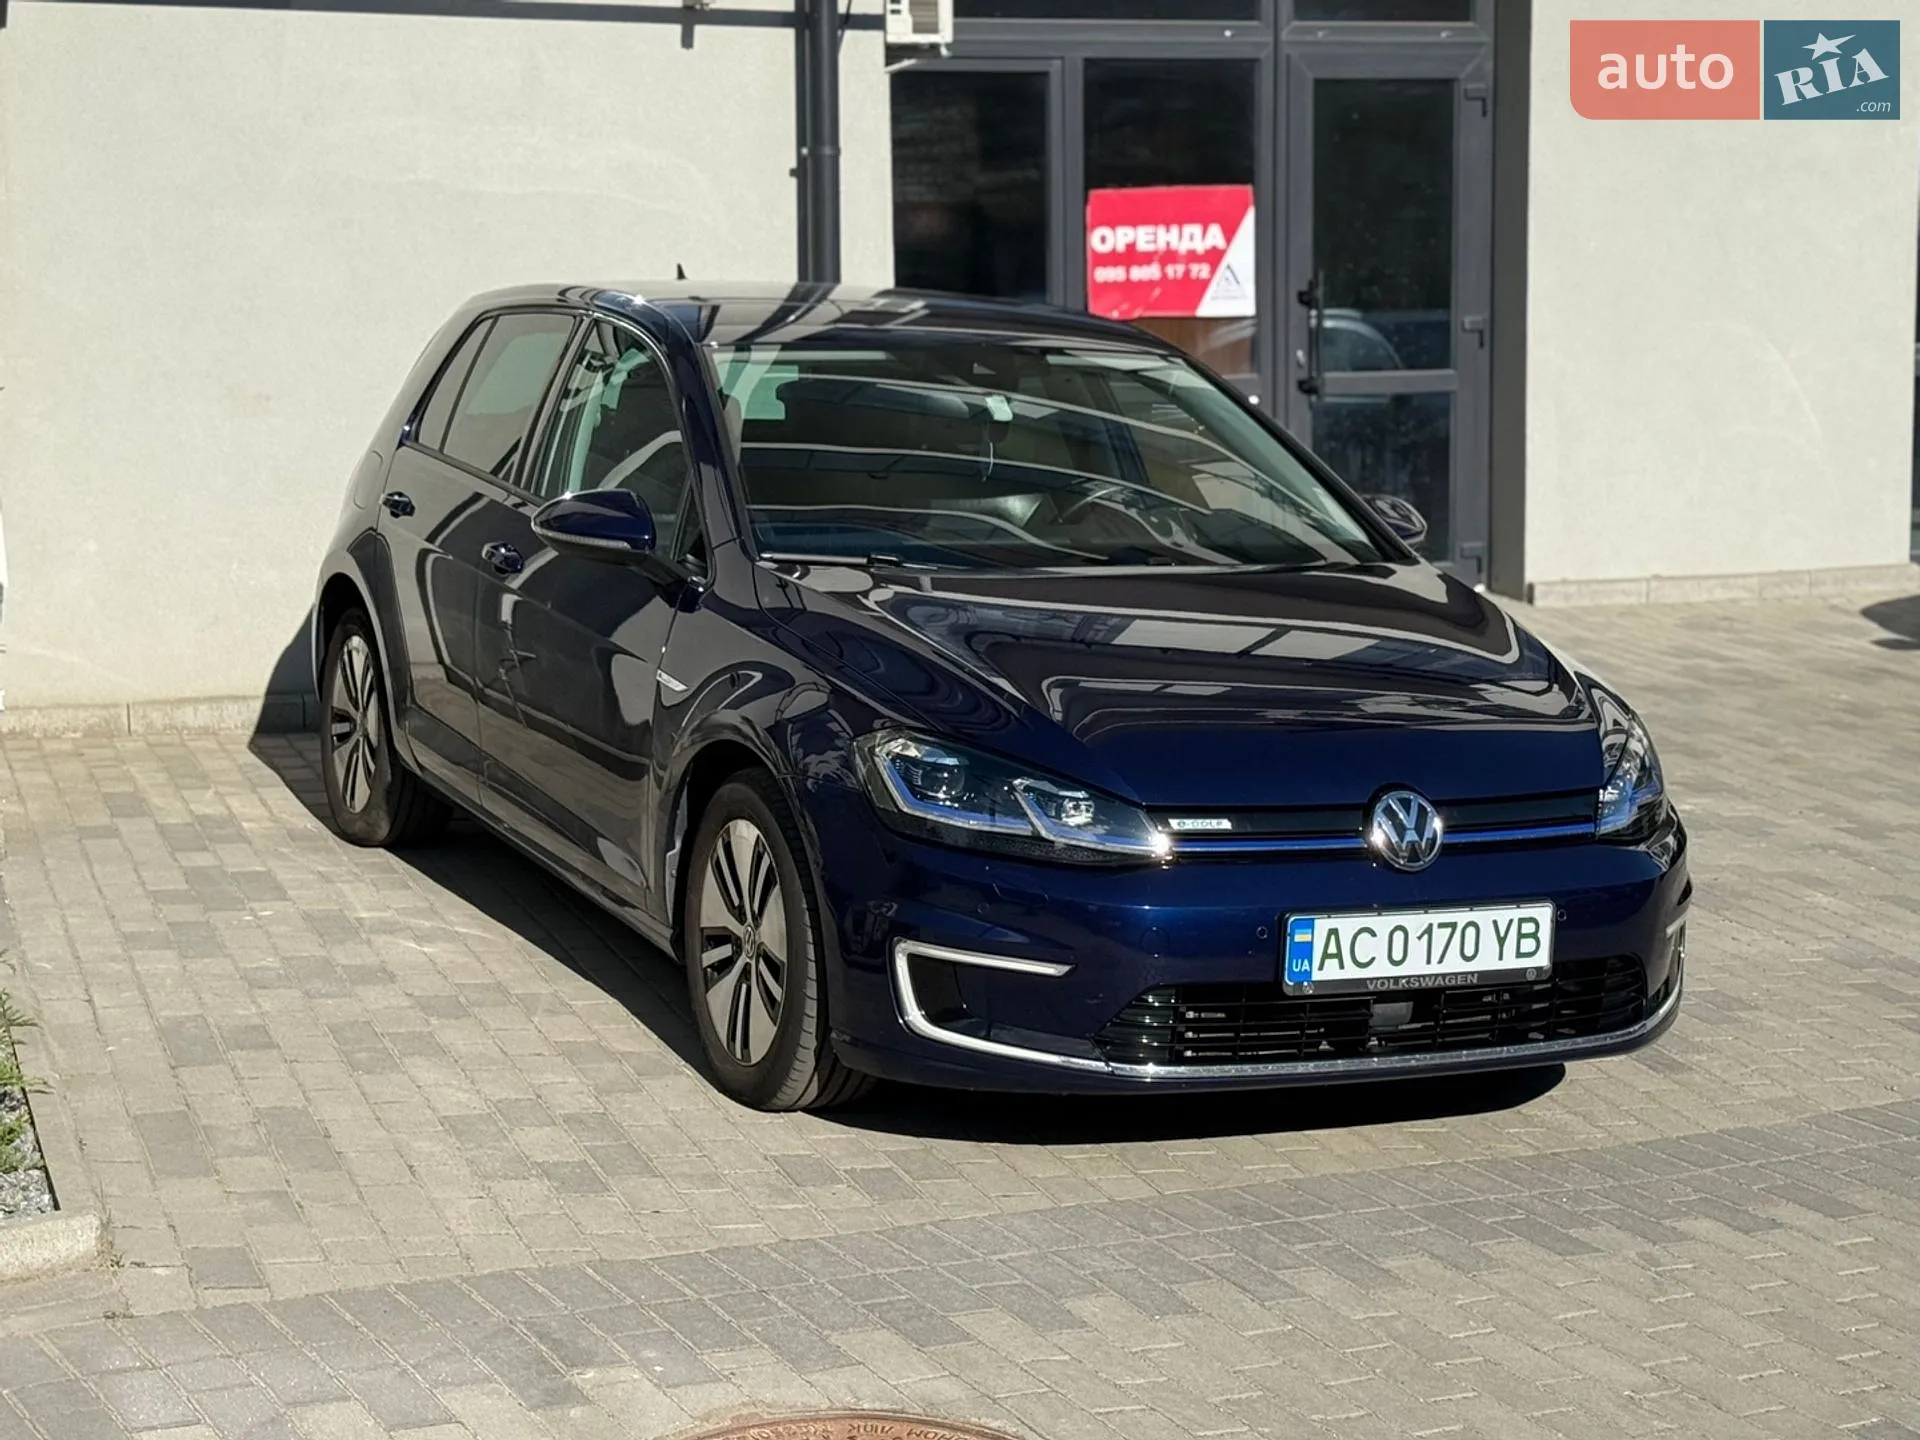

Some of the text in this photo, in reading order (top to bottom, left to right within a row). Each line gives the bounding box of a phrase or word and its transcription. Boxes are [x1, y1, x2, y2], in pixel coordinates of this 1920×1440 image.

[1090, 222, 1227, 255] ОРЕНДА
[1317, 916, 1541, 971] AC 0170 YB
[1292, 959, 1310, 972] UA
[1366, 973, 1479, 991] VOLKSWAGEN
